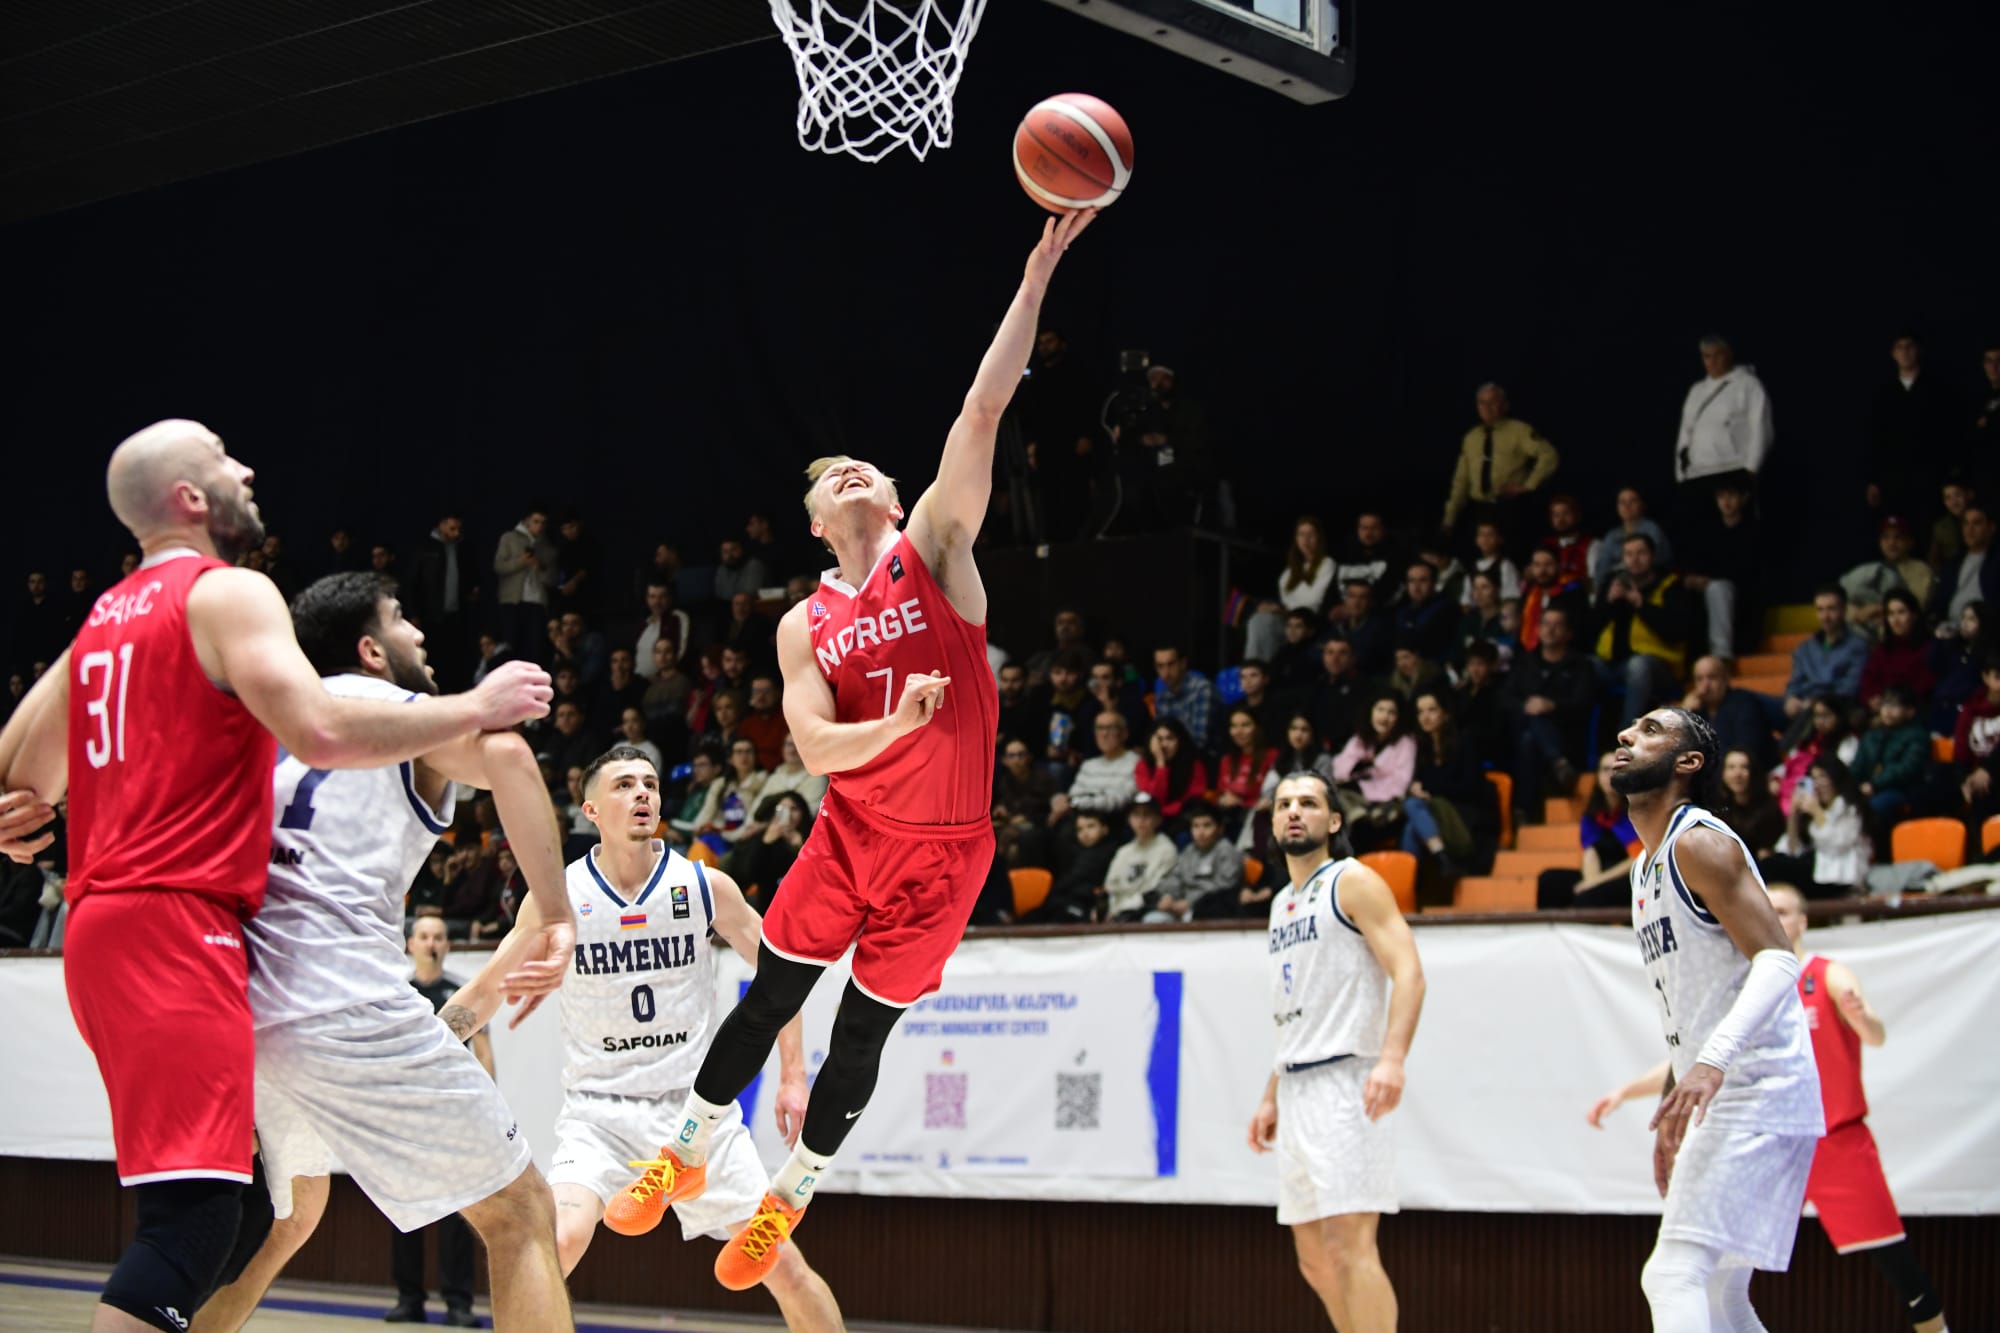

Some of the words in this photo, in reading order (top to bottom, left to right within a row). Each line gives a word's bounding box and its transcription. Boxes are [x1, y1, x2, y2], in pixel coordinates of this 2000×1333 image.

[816, 598, 928, 676] NORGE
[80, 643, 134, 769] 31
[866, 667, 893, 719] 7
[1270, 915, 1318, 953] RMENIA
[575, 934, 696, 975] ARMENIA
[1282, 963, 1293, 995] 5
[631, 984, 656, 1023] 0
[602, 1031, 688, 1052] SAFOIAN
